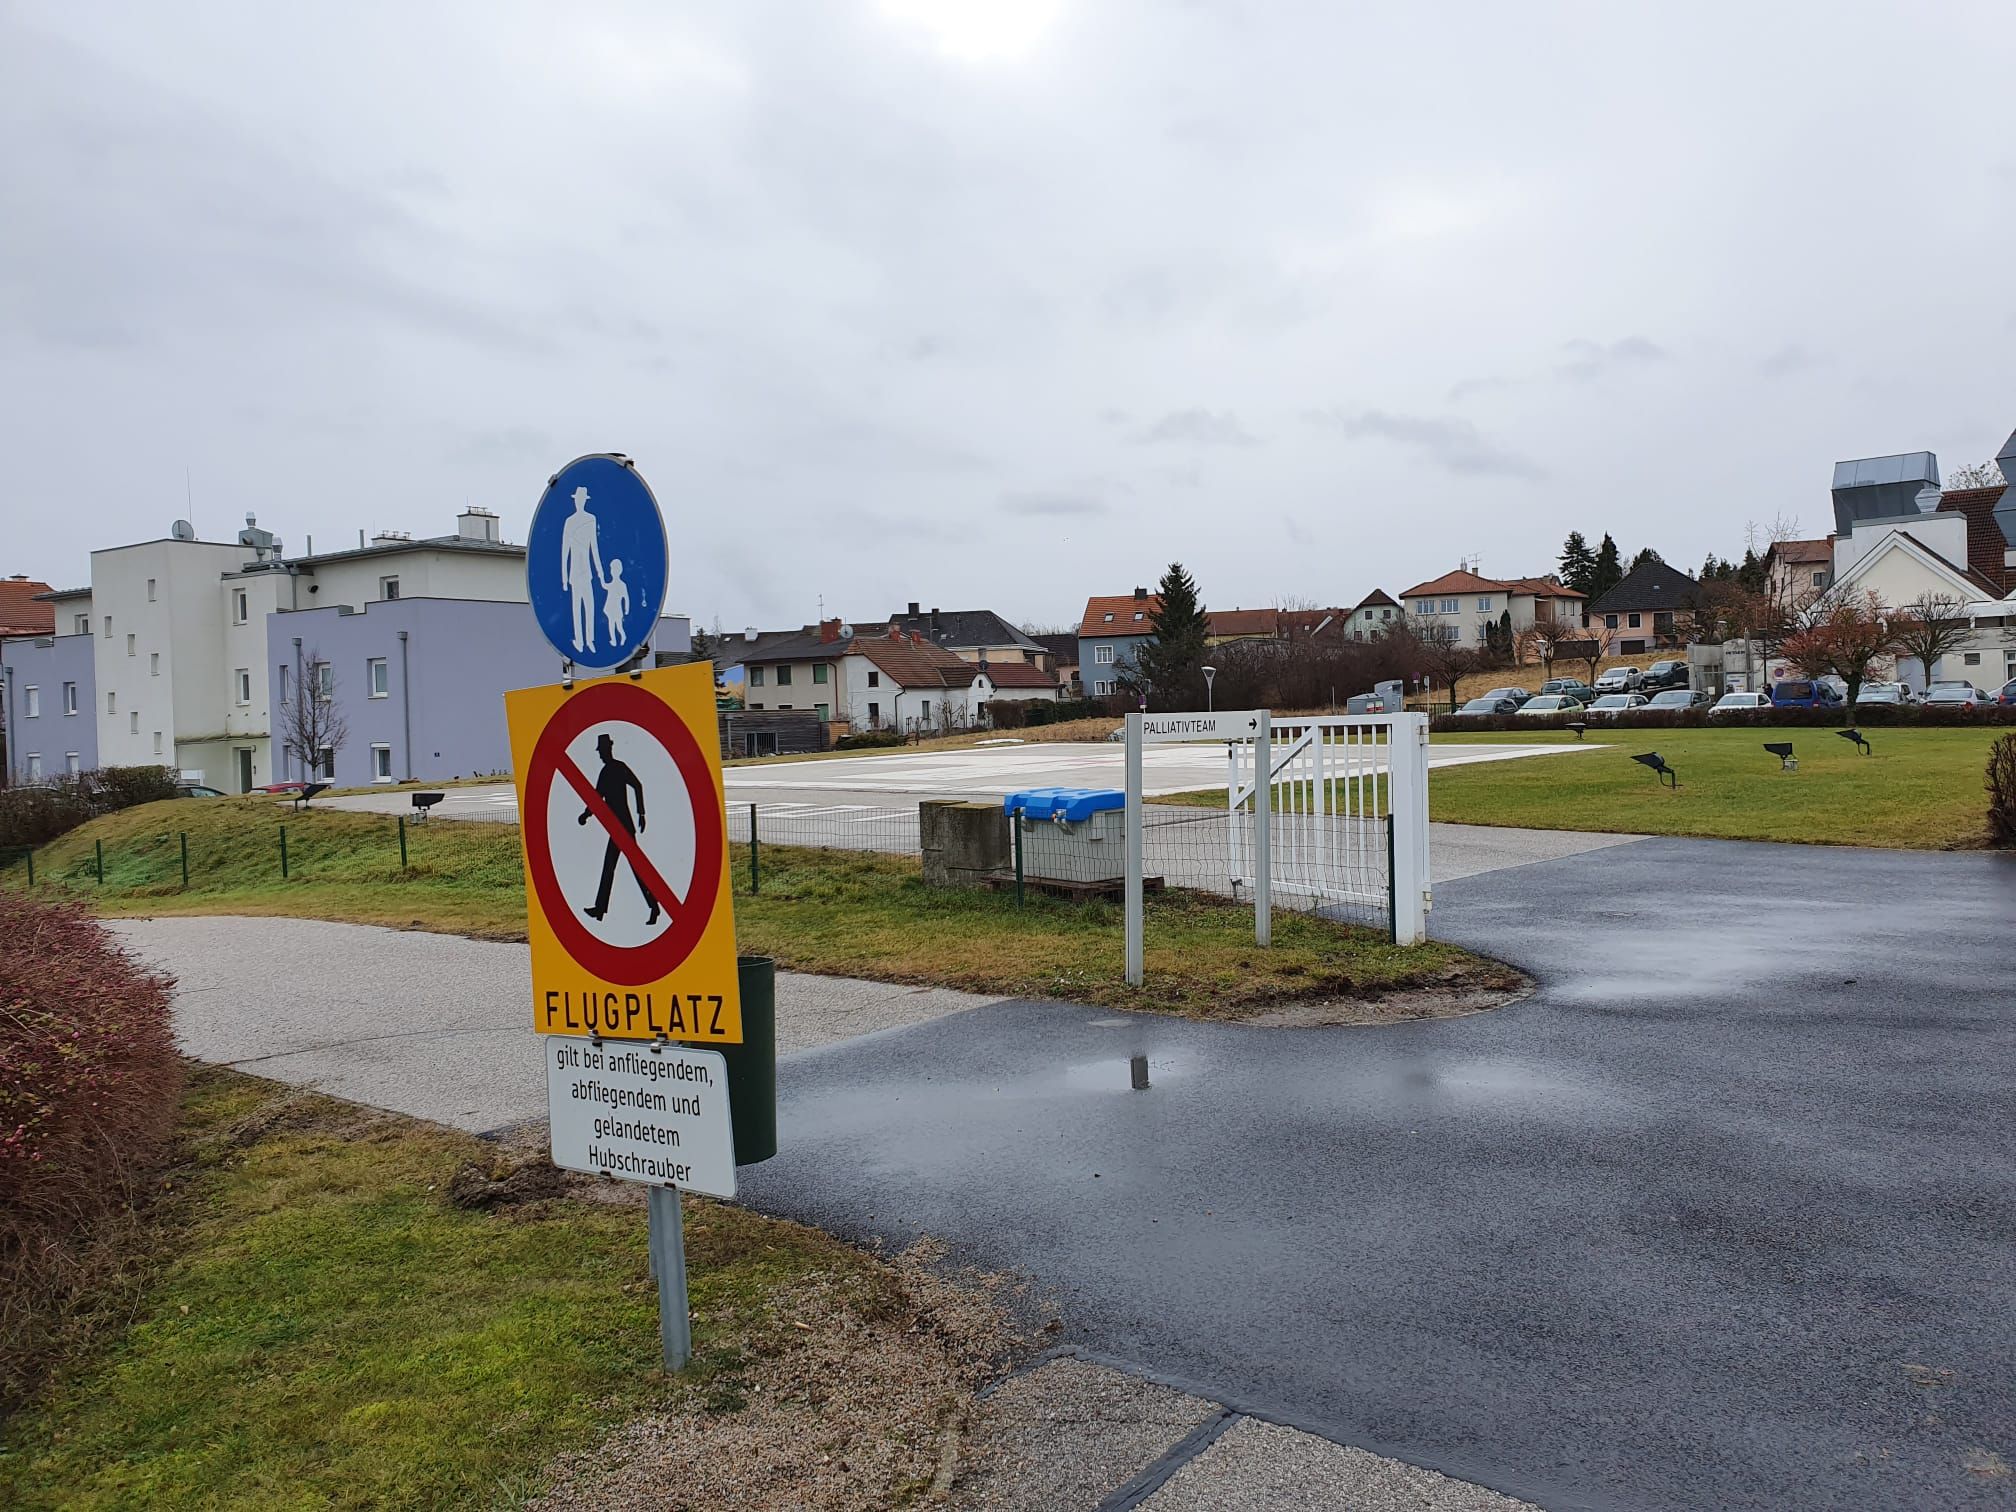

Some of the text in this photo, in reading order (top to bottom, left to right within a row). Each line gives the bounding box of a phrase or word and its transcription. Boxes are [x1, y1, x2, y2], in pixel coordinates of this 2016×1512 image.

[1143, 719, 1216, 735] PALLIATIVTEAM
[545, 991, 726, 1035] FLUGPLATZ
[557, 1045, 714, 1088] gilt bei anfliegendem,
[571, 1079, 701, 1117] abfliegendem und
[594, 1115, 680, 1147] gelandetem
[588, 1144, 692, 1182] Hubschrauber
